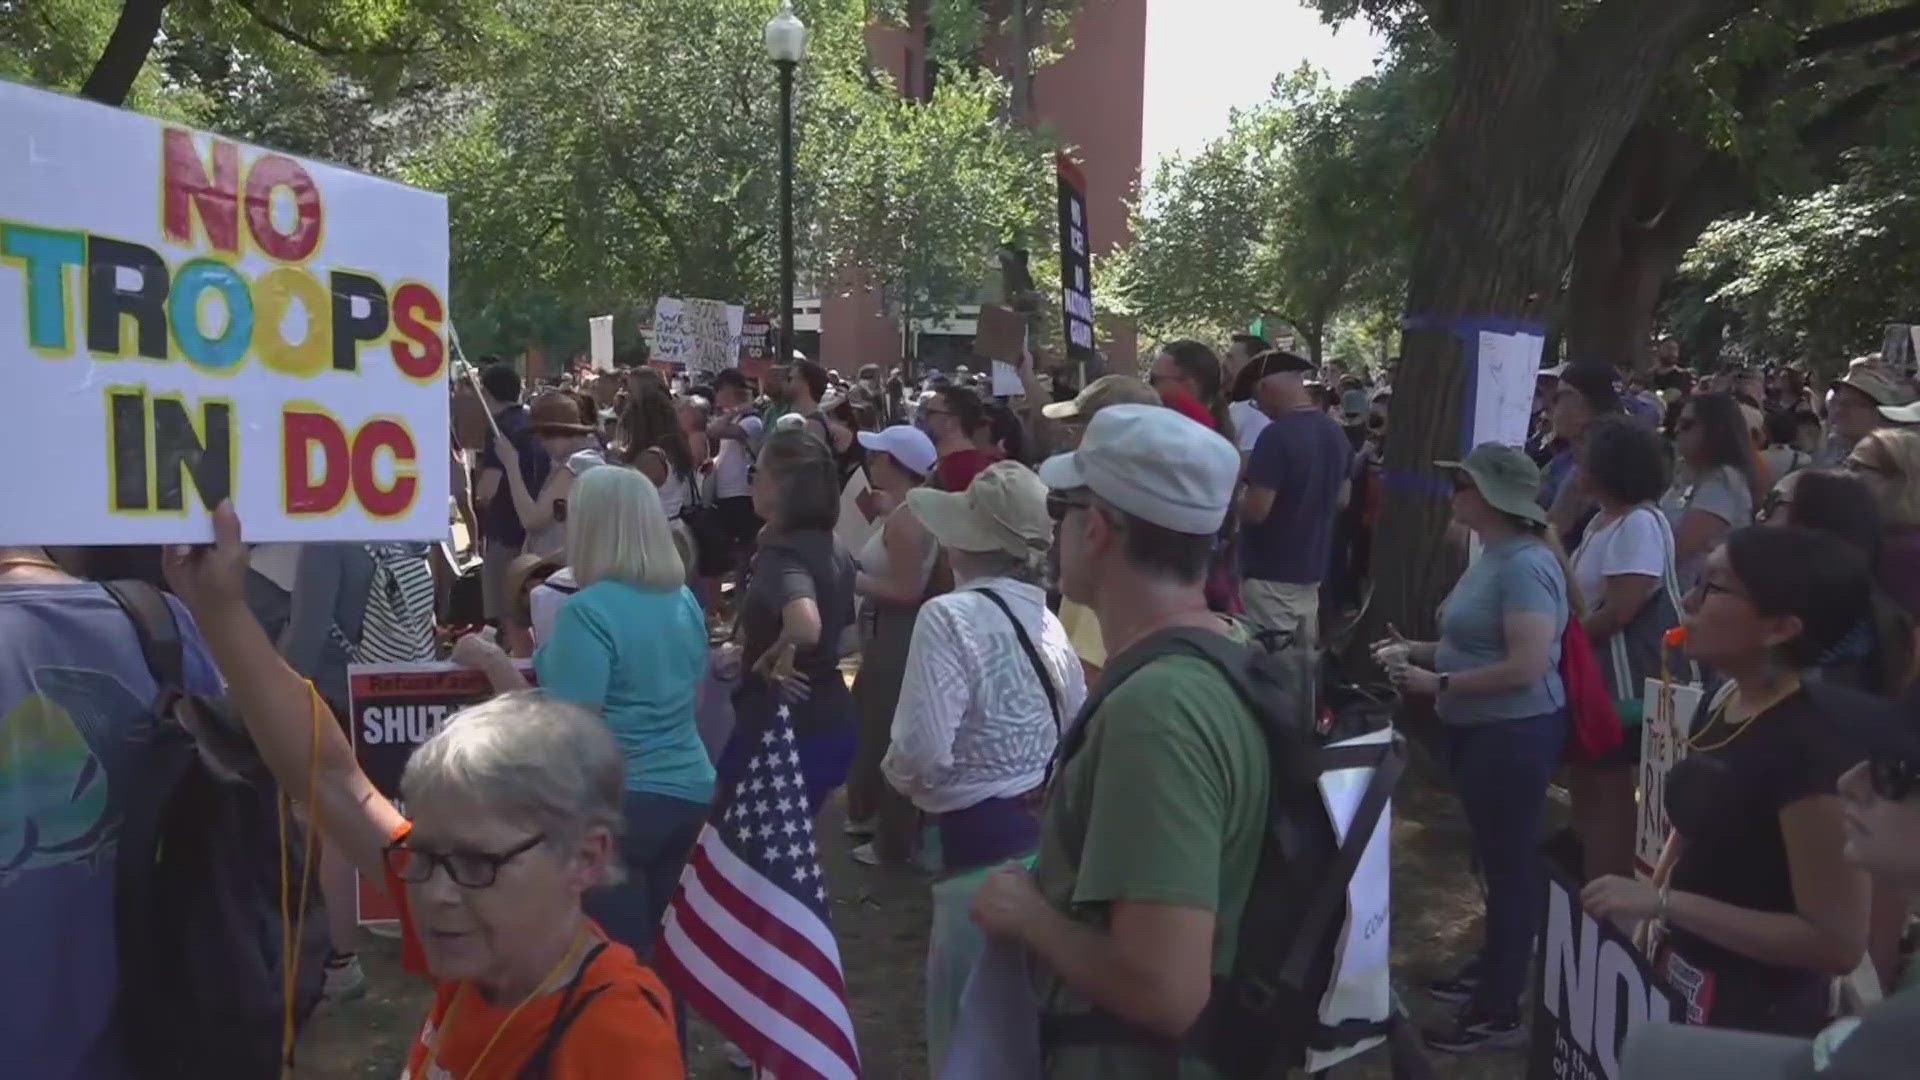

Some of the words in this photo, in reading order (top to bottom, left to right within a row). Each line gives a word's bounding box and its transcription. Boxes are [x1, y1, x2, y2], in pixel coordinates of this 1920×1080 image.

[162, 126, 322, 262] NO
[1, 221, 446, 379] TROOPS
[107, 388, 234, 514] IN
[281, 405, 418, 518] DC
[363, 704, 448, 744] SHUT
[1544, 879, 1670, 1080] NO
